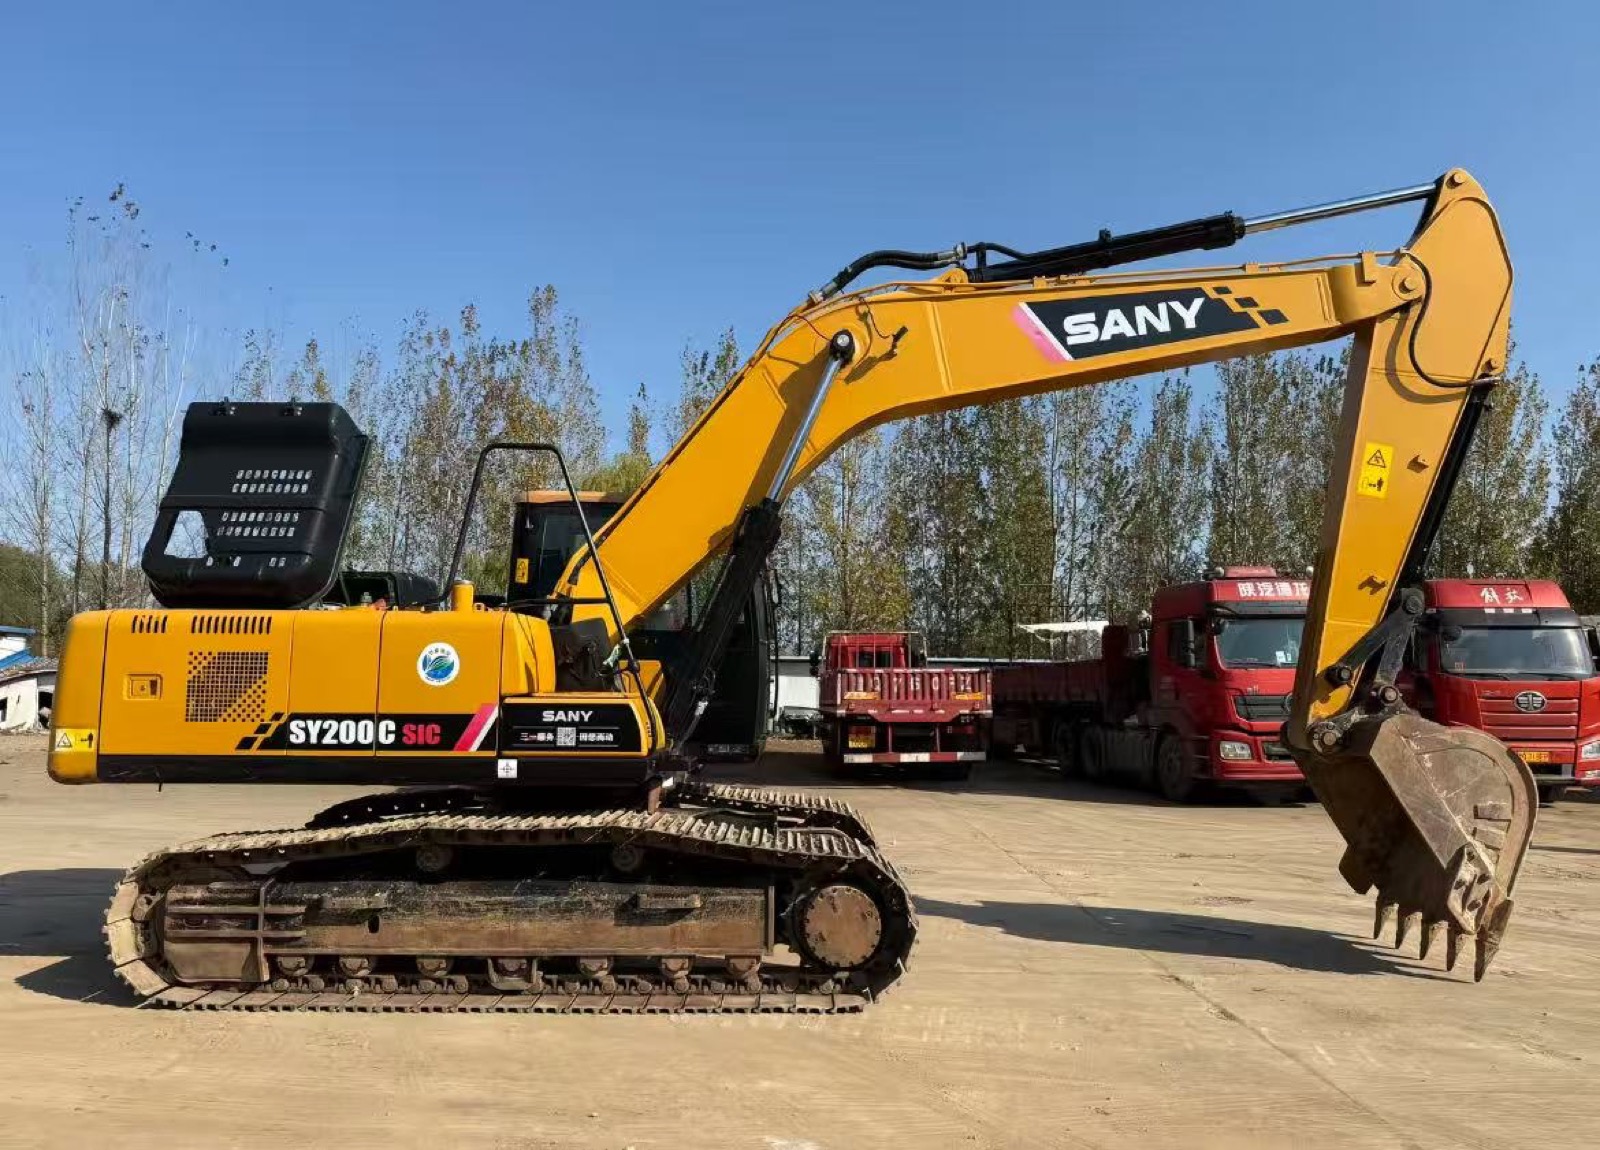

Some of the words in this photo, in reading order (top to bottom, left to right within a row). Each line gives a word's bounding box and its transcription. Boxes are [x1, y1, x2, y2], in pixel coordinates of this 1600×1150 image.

[1063, 297, 1205, 346] SANY
[542, 710, 593, 722] SANY
[289, 719, 396, 745] SY200C
[402, 724, 441, 745] SIC
